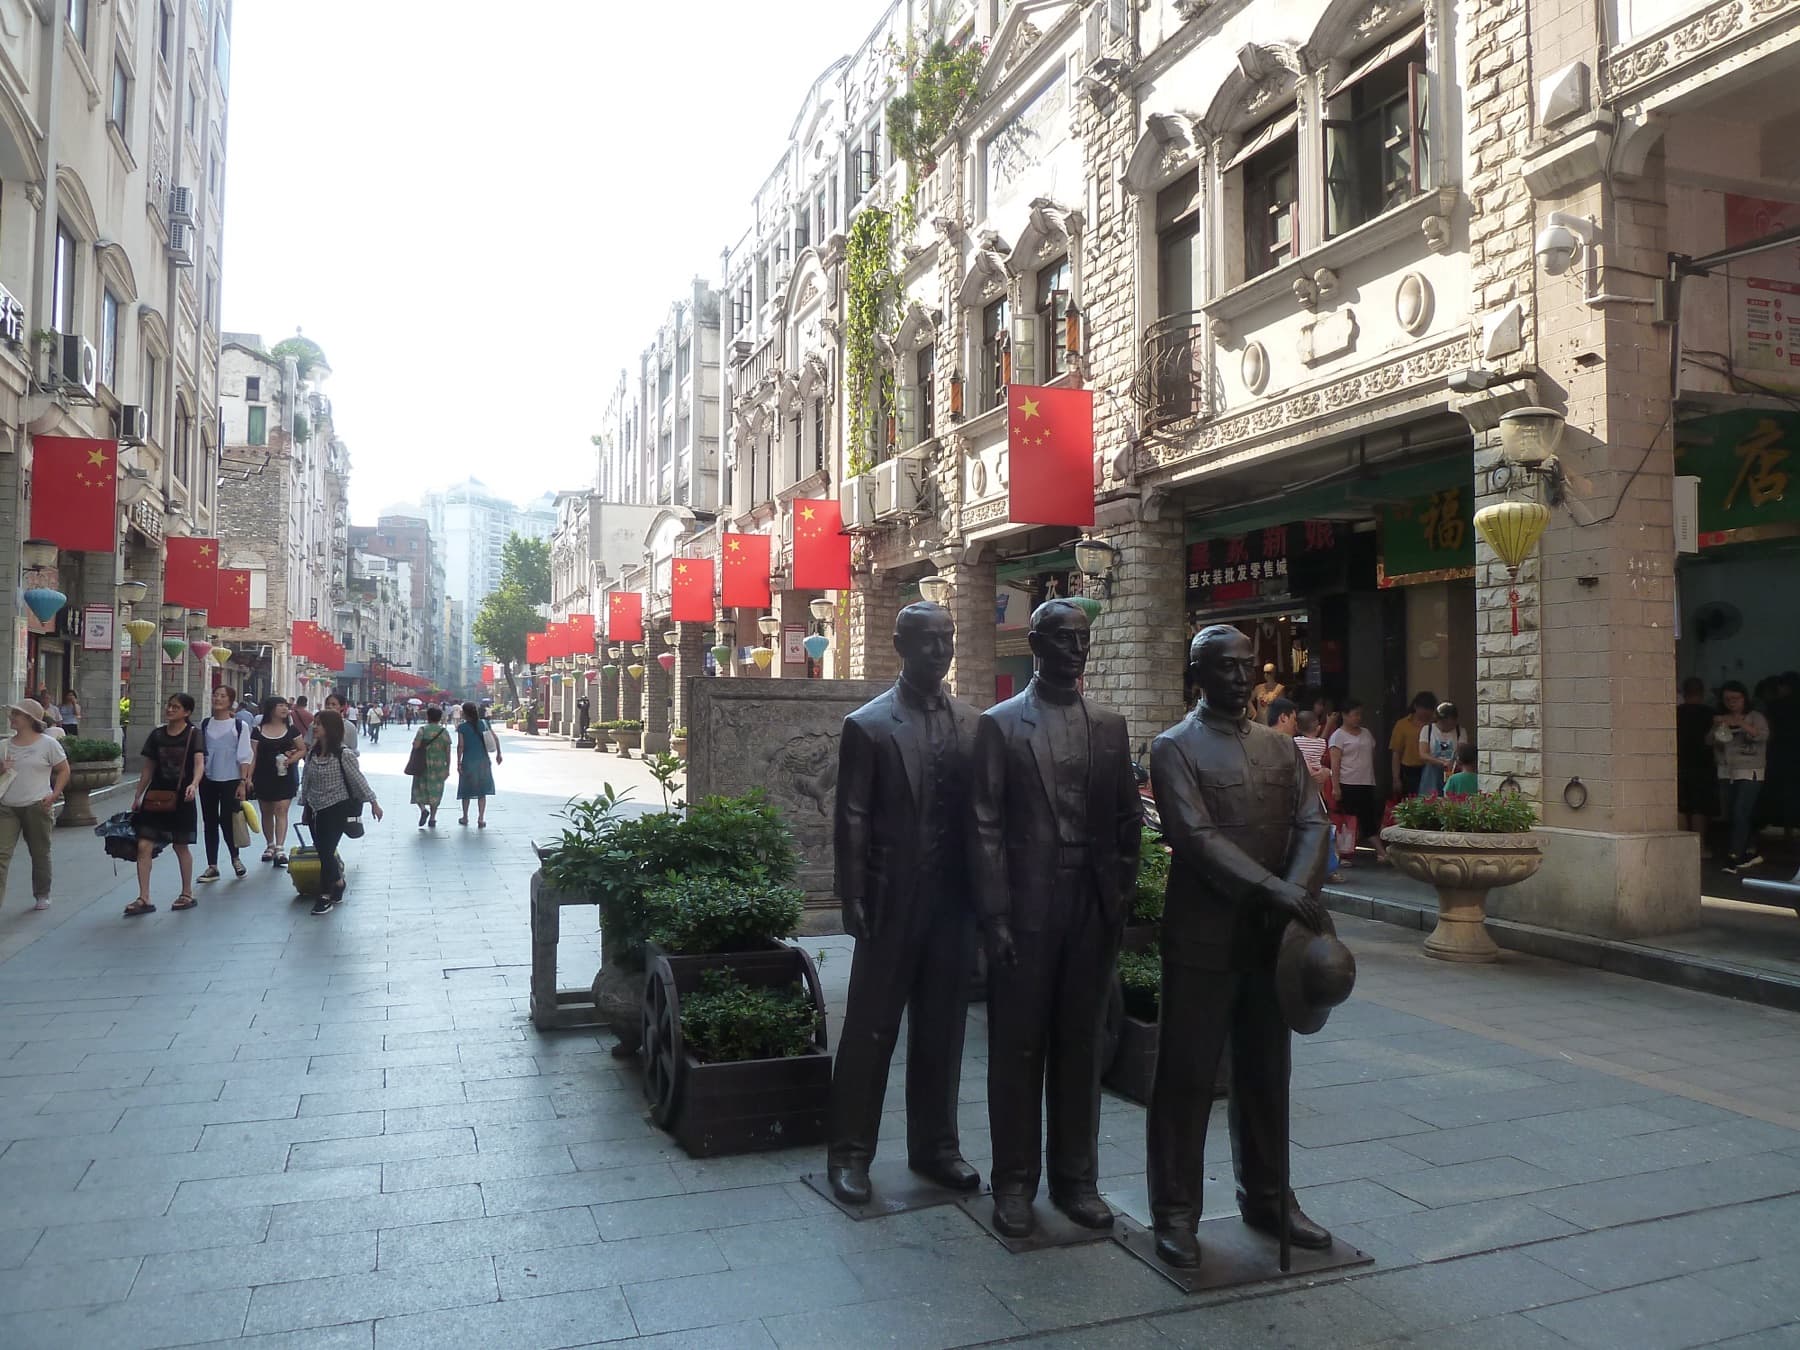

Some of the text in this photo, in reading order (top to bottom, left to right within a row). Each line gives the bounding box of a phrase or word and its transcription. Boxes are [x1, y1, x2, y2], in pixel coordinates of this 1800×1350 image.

[1185, 557, 1289, 590] 型女装批发零售城
